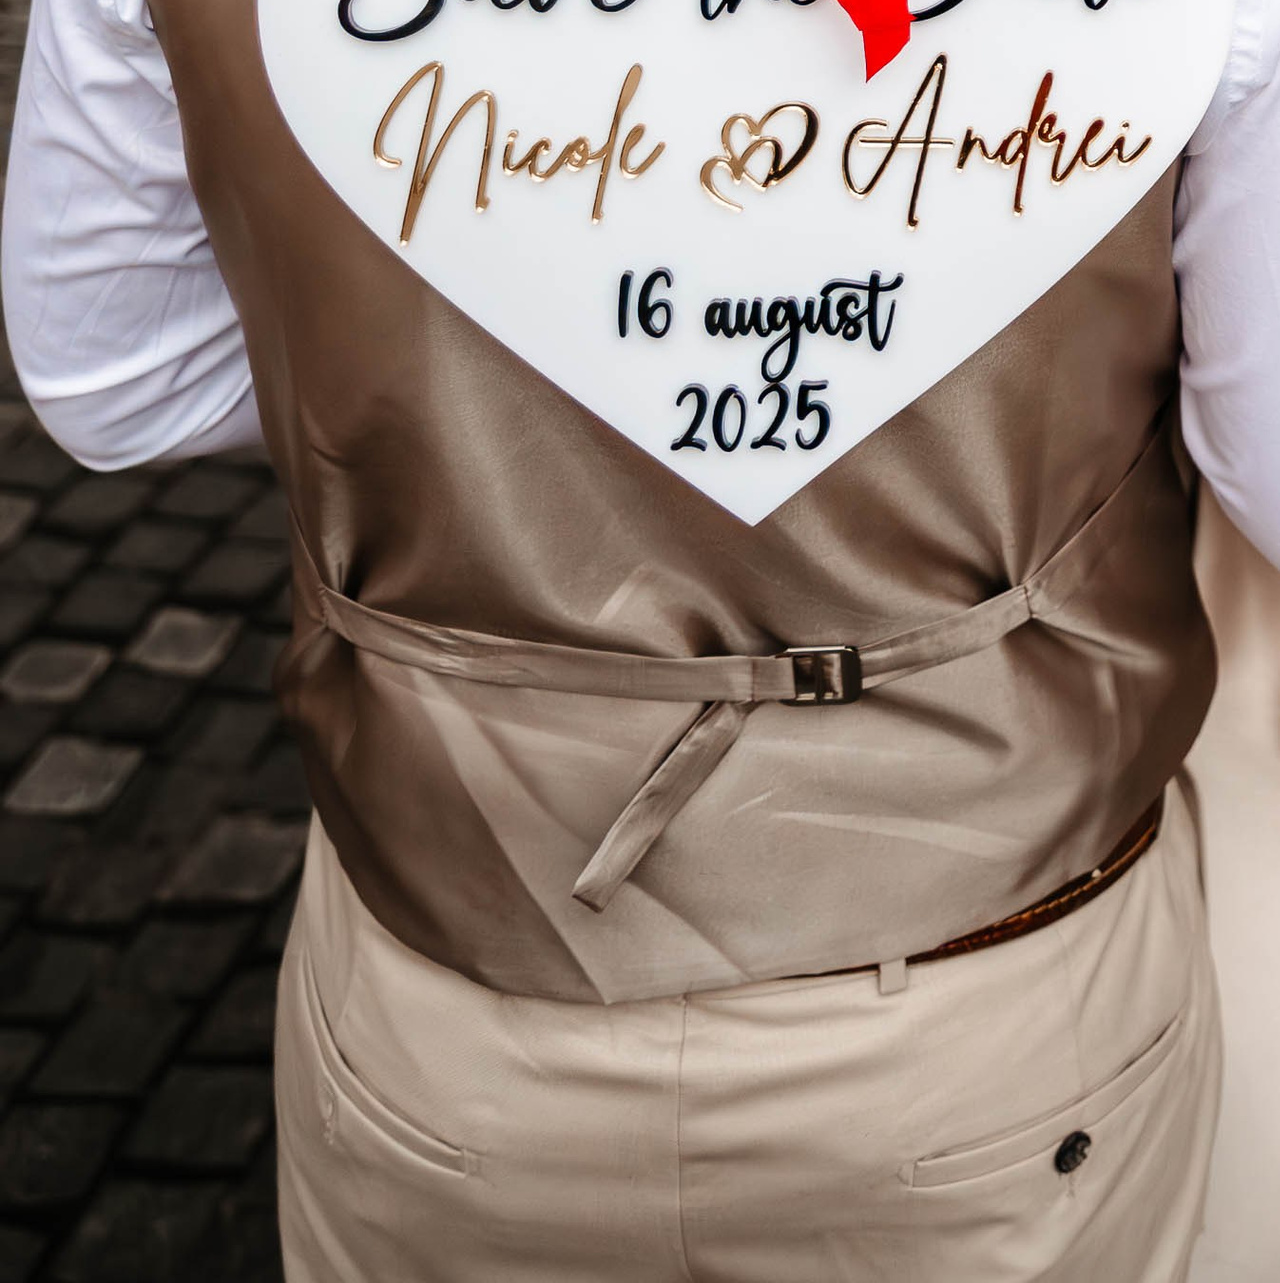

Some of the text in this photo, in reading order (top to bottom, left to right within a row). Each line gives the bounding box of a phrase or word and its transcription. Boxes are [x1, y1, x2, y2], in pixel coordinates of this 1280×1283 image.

[372, 52, 1152, 246] Nicole Andrei
[616, 266, 905, 383] 16 august
[669, 379, 833, 453] 2025
